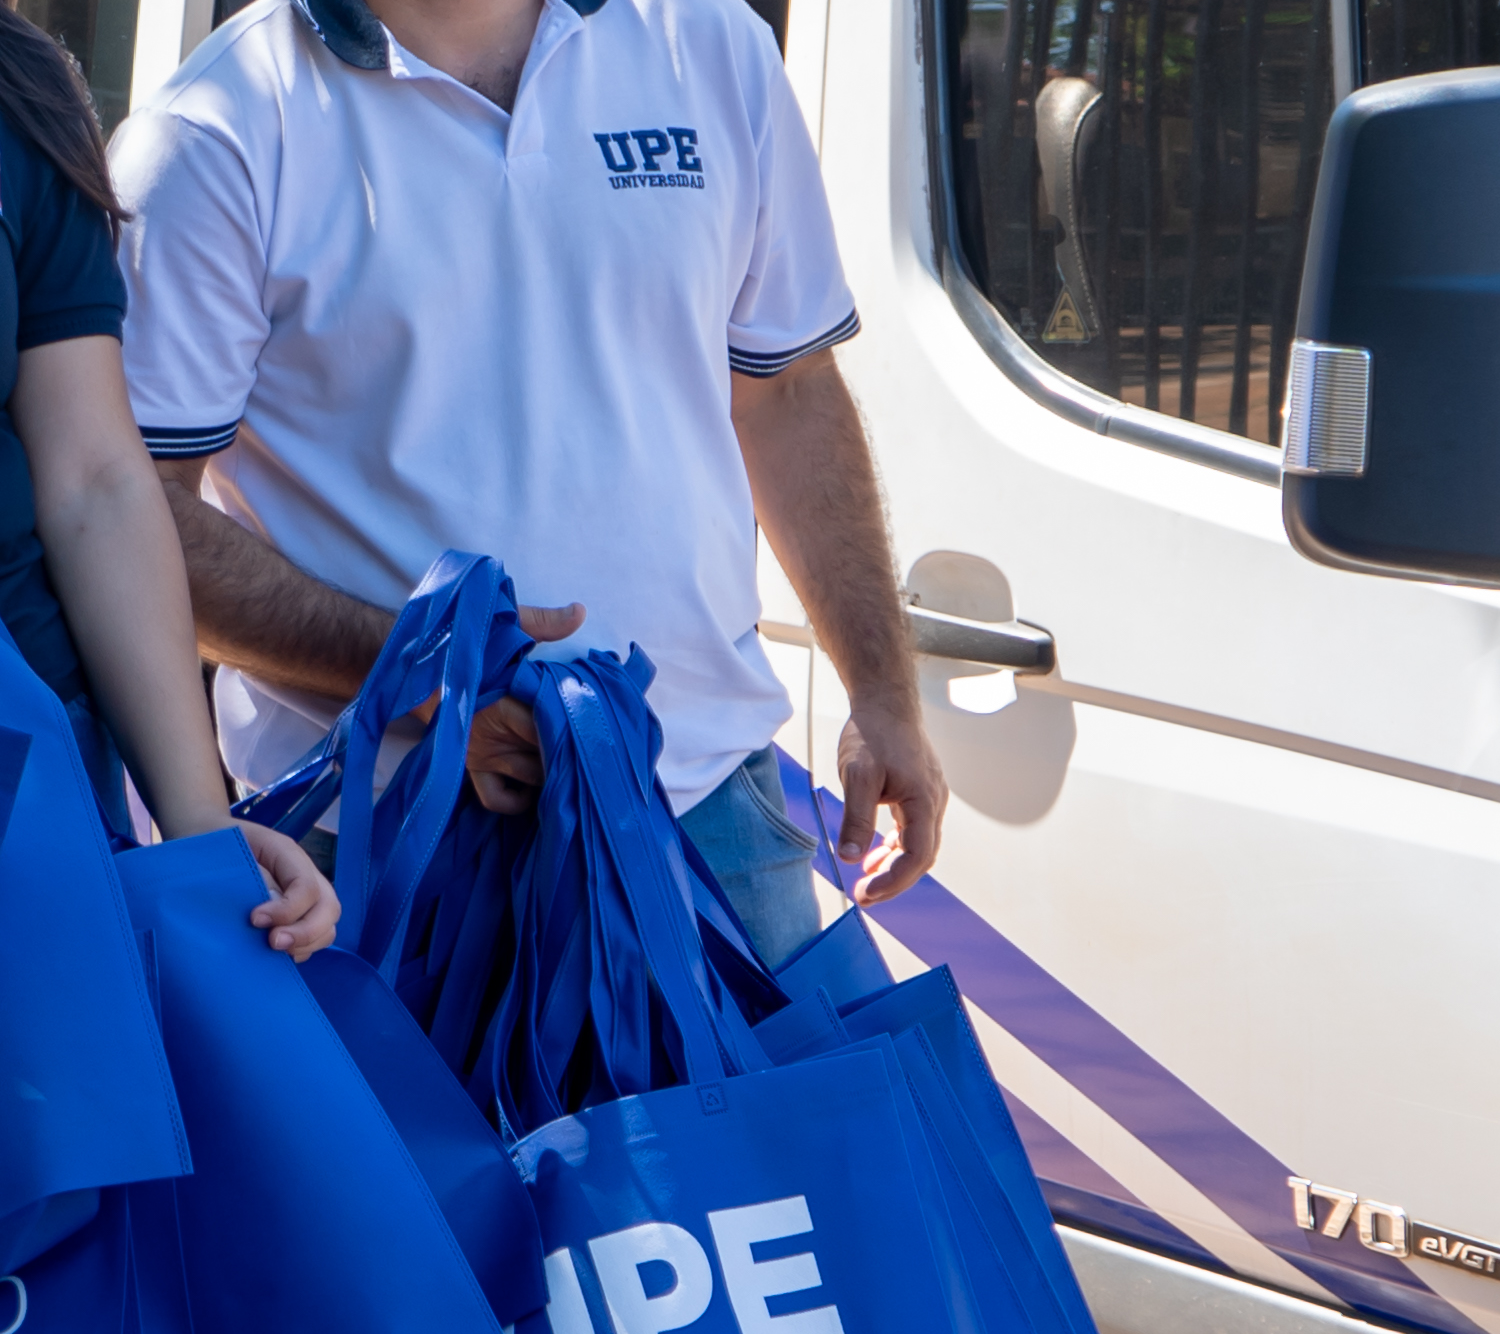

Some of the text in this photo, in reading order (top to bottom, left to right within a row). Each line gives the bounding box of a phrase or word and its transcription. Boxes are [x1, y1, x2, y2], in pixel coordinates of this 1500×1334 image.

[593, 127, 704, 173] UPE
[608, 173, 706, 190] UNIVERSIDAD
[1287, 1175, 1411, 1259] 170
